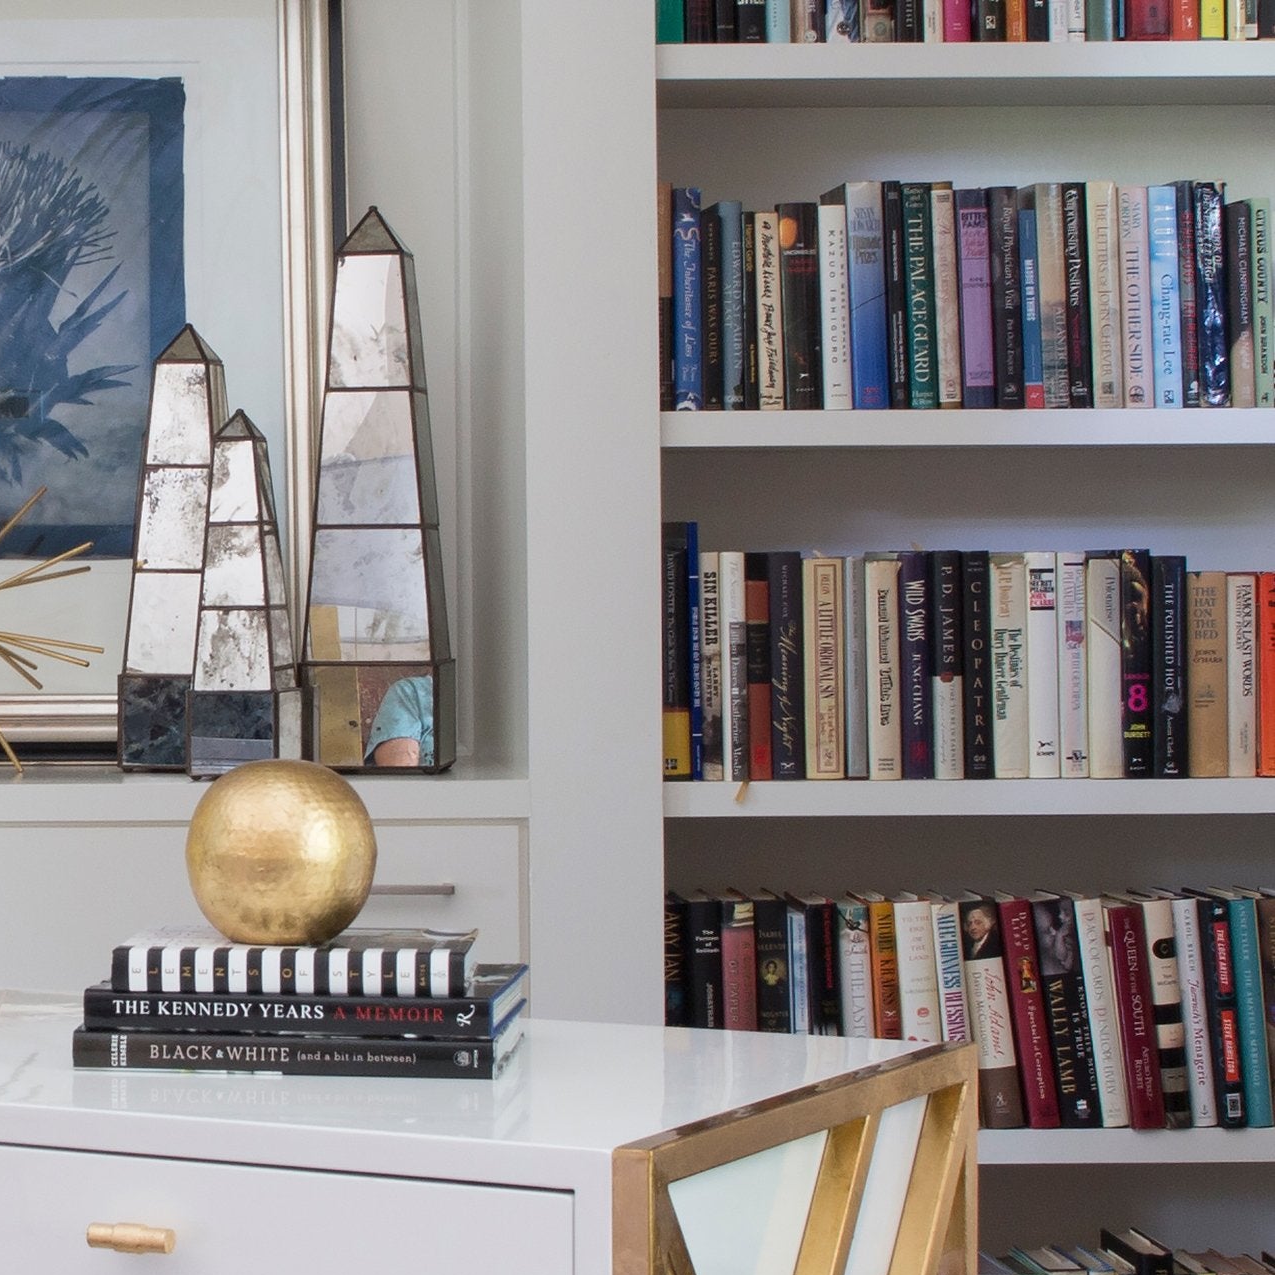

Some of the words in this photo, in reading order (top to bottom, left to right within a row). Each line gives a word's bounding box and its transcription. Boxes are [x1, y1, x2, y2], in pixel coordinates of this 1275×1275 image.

[907, 213, 925, 253] THE
[1237, 216, 1247, 258] MICHAEL
[1256, 208, 1268, 254] CITRUS
[828, 230, 837, 278] KAZUO
[909, 256, 928, 320] PALACE
[1239, 260, 1249, 324] CUNNINGHAM
[1256, 257, 1268, 304] COUNTY
[1155, 273, 1173, 344] Chang-rae
[1260, 315, 1268, 334] JOHN
[829, 289, 838, 364] ISHIGURO
[912, 324, 930, 382] GUARD
[1162, 351, 1175, 375] Lee
[1260, 336, 1269, 374] BRANDON
[703, 571, 716, 594] SIN
[940, 565, 953, 575] P.
[905, 580, 925, 605] WILD
[941, 583, 953, 598] D.
[1164, 583, 1174, 605] THE
[1193, 586, 1216, 596] THE
[1194, 598, 1216, 607] HAT
[1241, 583, 1252, 628] FAMOUS
[704, 597, 718, 646] KILLER
[905, 608, 926, 641] SWANS
[1194, 609, 1212, 618] ON
[1194, 619, 1216, 629] THE
[939, 605, 955, 663] JAMES
[1165, 608, 1174, 664] POLISHED
[1194, 630, 1219, 640] BED
[1241, 630, 1252, 657] LAST
[911, 653, 921, 682] JUNG
[970, 582, 983, 745] CLEOPATRA
[1165, 668, 1174, 691] HOE
[1242, 659, 1253, 697] WORDS
[912, 684, 923, 726] CHANG
[1128, 684, 1148, 712] 8
[1183, 908, 1193, 940] CAROL
[1186, 943, 1196, 972] BIRCH
[113, 1000, 150, 1015] THE
[158, 1001, 252, 1017] KENNEDY
[259, 1004, 324, 1019] YEARS
[333, 1007, 346, 1020] A
[356, 1007, 444, 1022] MEMOIR
[1048, 979, 1069, 1036] WALLY
[1187, 978, 1203, 1025] Jamrach's
[1223, 1019, 1232, 1040] STEVE
[150, 1044, 212, 1060] BLACK
[215, 1049, 224, 1059] &
[226, 1046, 289, 1062] WHITE
[297, 1049, 321, 1062] (and
[334, 1053, 349, 1062] bit
[353, 1053, 363, 1062] in
[367, 1053, 417, 1064] between)
[1056, 1046, 1076, 1095] LAMB
[1193, 1027, 1207, 1086] Menagerie
[1224, 1041, 1235, 1073] HAMILTON
